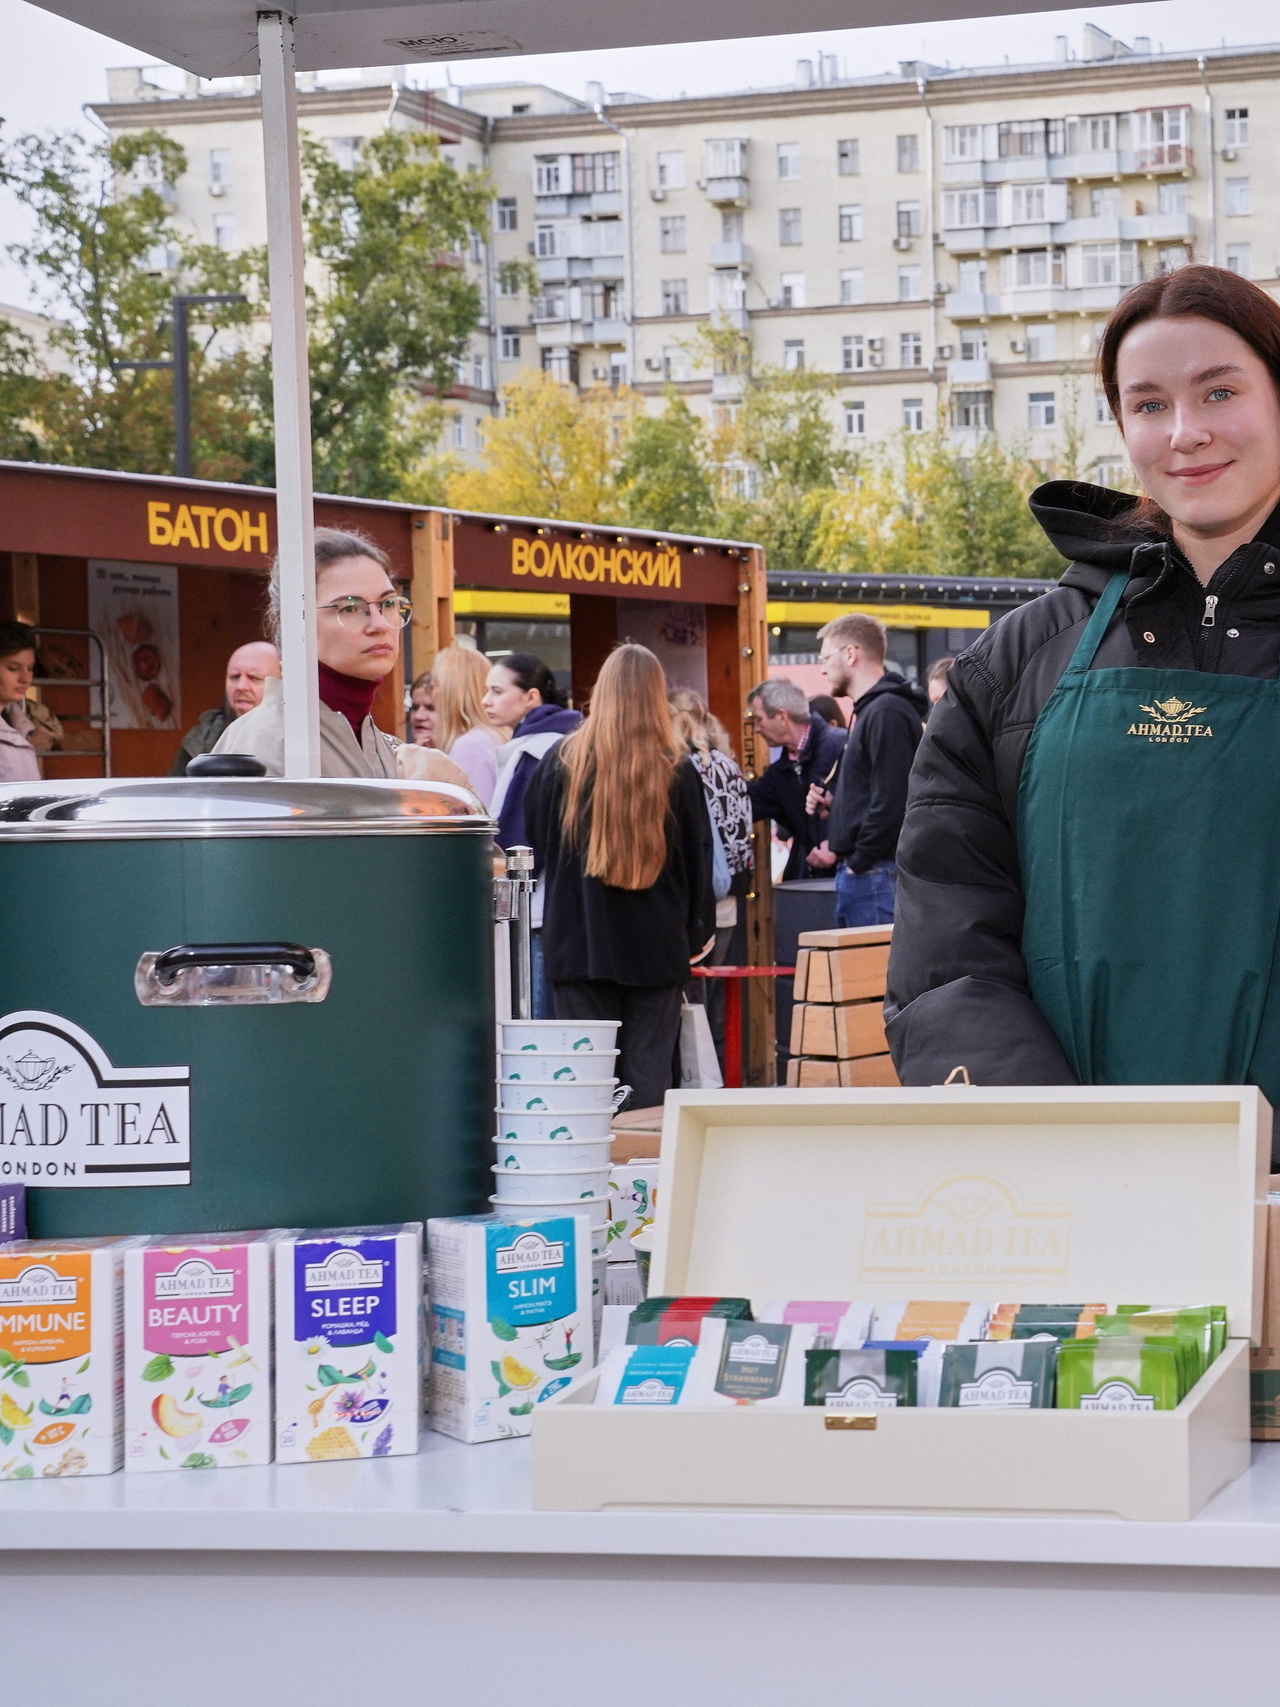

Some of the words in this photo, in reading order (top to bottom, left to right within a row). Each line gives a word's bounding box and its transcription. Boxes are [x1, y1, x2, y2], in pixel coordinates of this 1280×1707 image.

[147, 501, 269, 554] БАТОН
[511, 538, 682, 589] ВОЛКОНСКИЙ
[1126, 723, 1183, 736] AHMAD
[1184, 725, 1214, 737] TEA
[1148, 736, 1190, 744] LONDON
[80, 1101, 181, 1146] TEA
[870, 1226, 994, 1256] AHMAD
[1001, 1226, 1062, 1256] TEA
[499, 1251, 540, 1265] AHMAD
[541, 1249, 562, 1260] TEA
[309, 1269, 355, 1281] AHMAD
[357, 1268, 380, 1279] TEA
[929, 1265, 997, 1275] LONDON
[1, 1285, 49, 1298] AHMAD
[50, 1284, 74, 1296] TEA
[158, 1278, 205, 1291] AHMAD
[208, 1277, 231, 1289] TEA
[508, 1276, 556, 1299] SLIM
[310, 1295, 380, 1318] SLEEP
[148, 1303, 243, 1327] BEAUTY
[961, 1388, 1006, 1401] AHMAD
[1007, 1387, 1030, 1400] TEA
